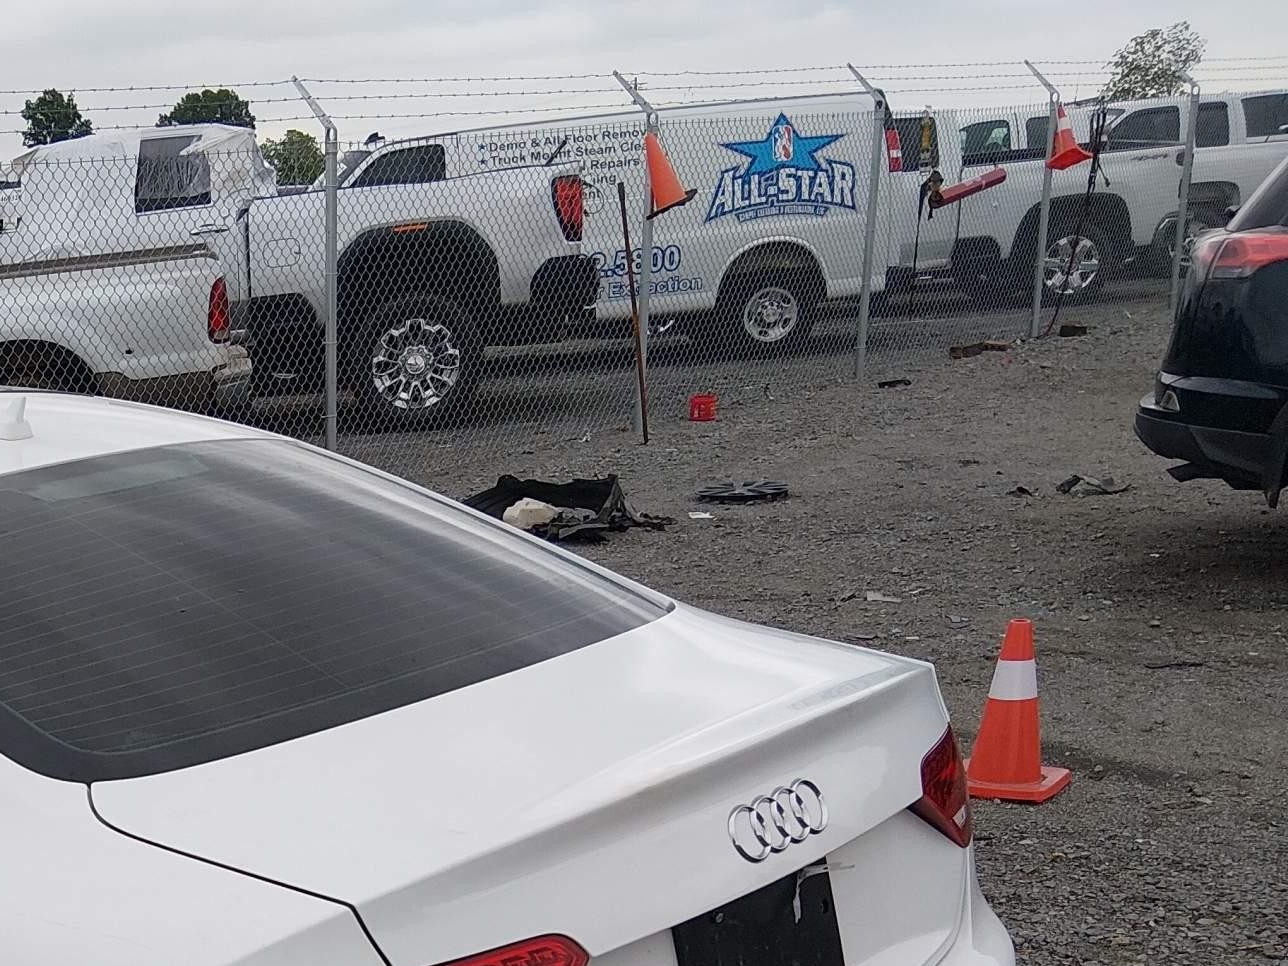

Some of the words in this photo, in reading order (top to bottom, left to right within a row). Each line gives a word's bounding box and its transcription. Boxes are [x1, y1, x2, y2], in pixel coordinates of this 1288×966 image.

[489, 141, 527, 153] Demo
[531, 138, 541, 148] &
[544, 136, 560, 147] All
[564, 133, 598, 144] Floor
[602, 129, 647, 141] Remov
[491, 155, 526, 167] Truck
[575, 144, 616, 157] Steam
[620, 141, 648, 153] Clea
[590, 157, 640, 171] Repairs
[708, 161, 855, 219] ALL-STAR
[579, 245, 682, 278] 2.5800
